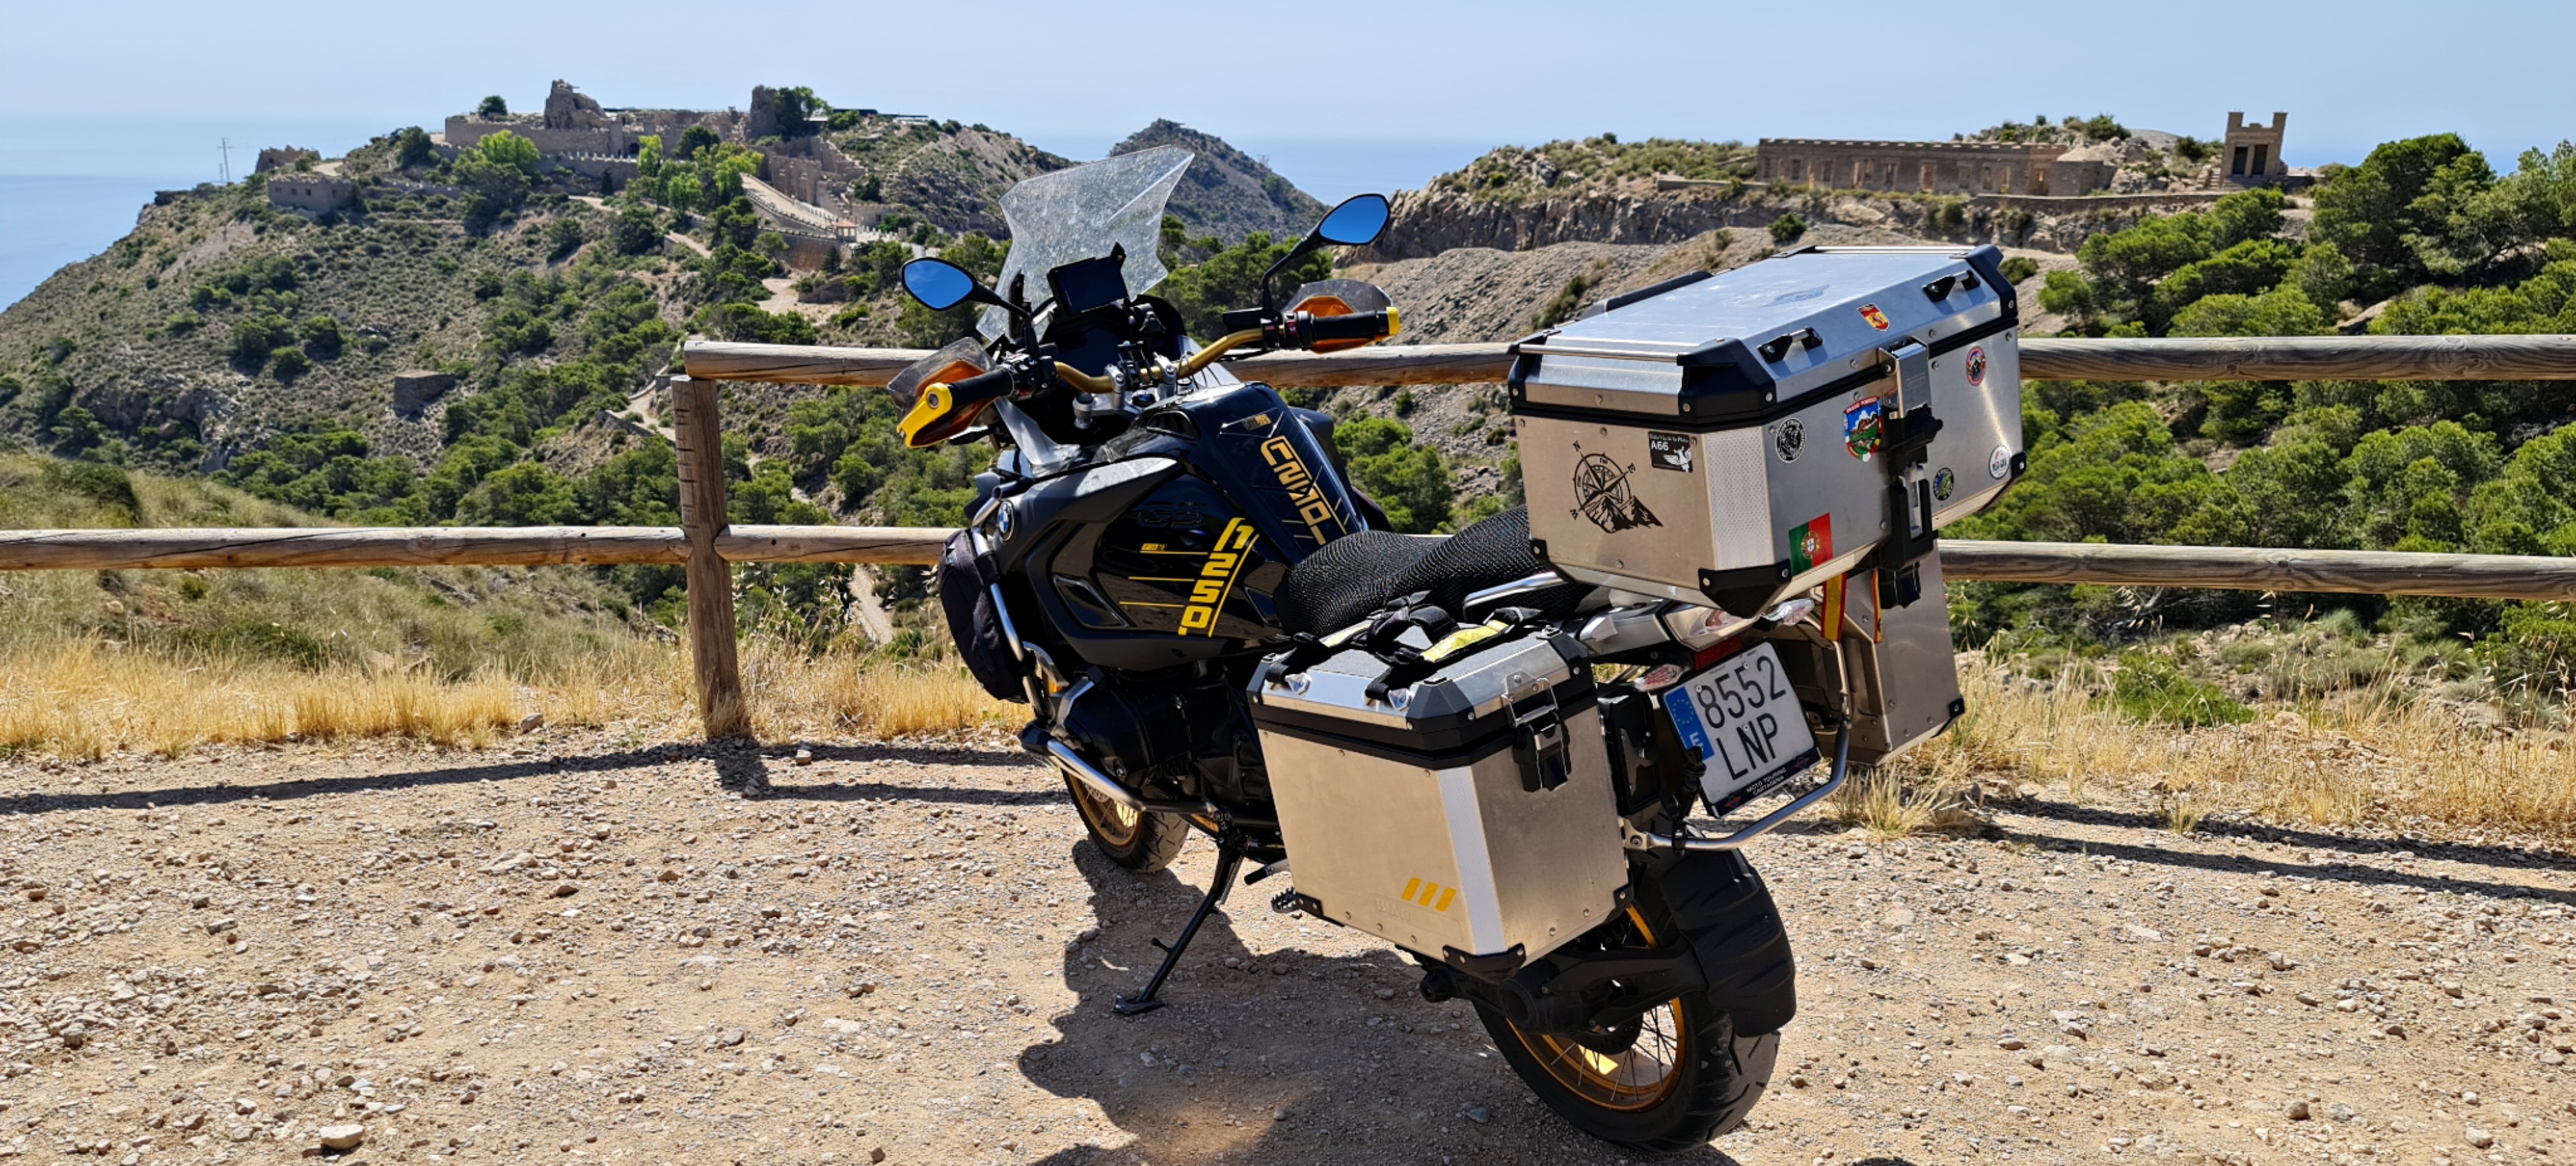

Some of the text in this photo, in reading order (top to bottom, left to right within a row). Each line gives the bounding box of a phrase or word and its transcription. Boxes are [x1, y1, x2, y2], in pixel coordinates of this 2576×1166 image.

[1651, 440, 1669, 451] A66
[1180, 524, 1255, 629] 1250
[1696, 656, 1786, 729] 8552
[1716, 712, 1778, 781] LNP
[1746, 781, 1763, 793] MOTO
